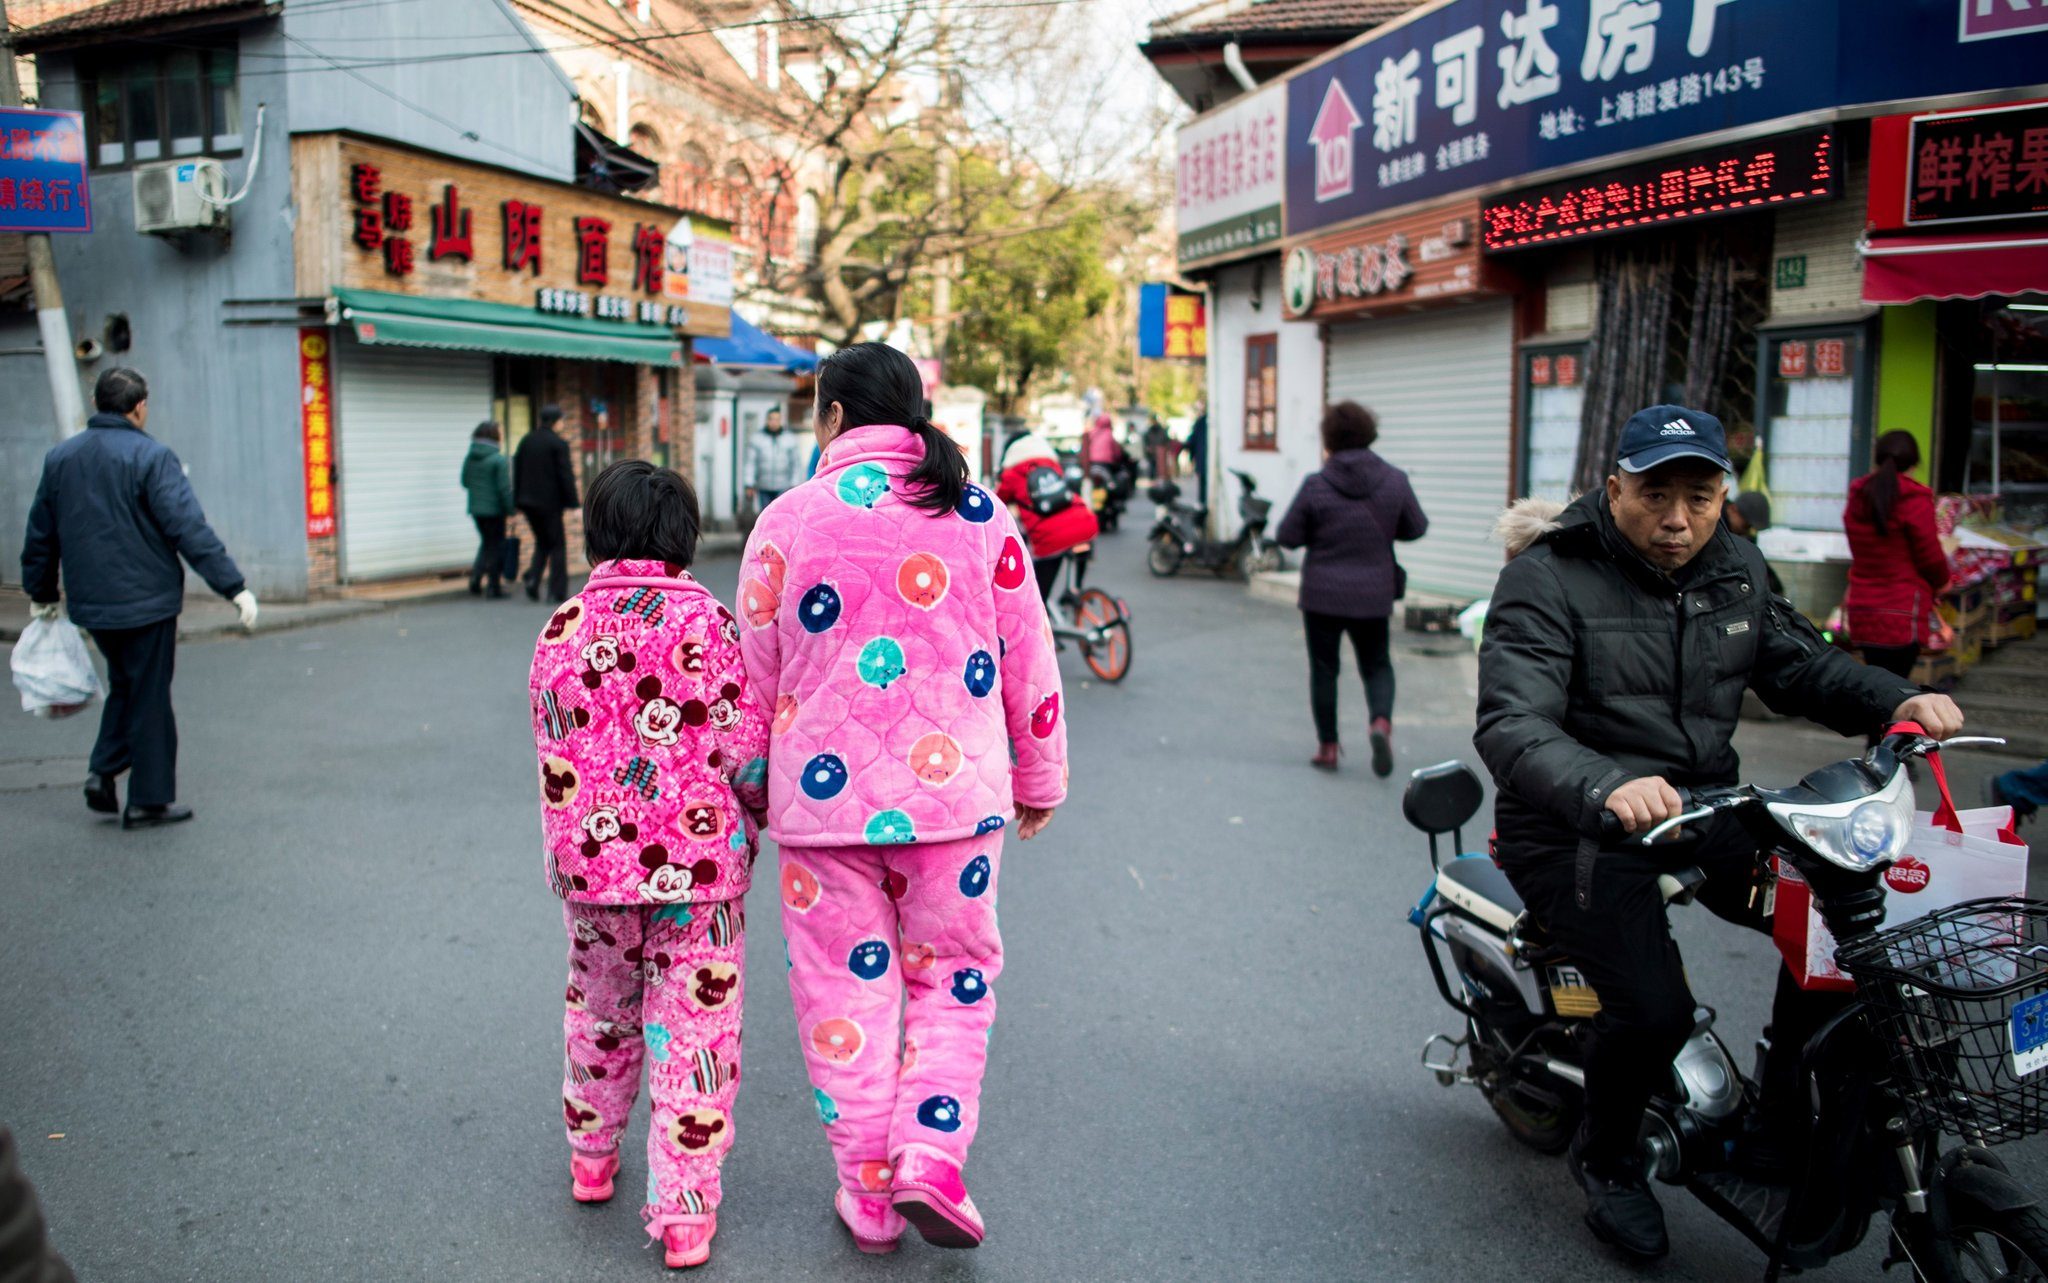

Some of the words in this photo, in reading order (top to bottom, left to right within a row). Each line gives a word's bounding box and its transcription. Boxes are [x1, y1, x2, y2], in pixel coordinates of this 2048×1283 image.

[1319, 136, 1349, 186] KD
[1917, 128, 2048, 203] 鲜榨果
[430, 183, 664, 294] 山阴面馆
